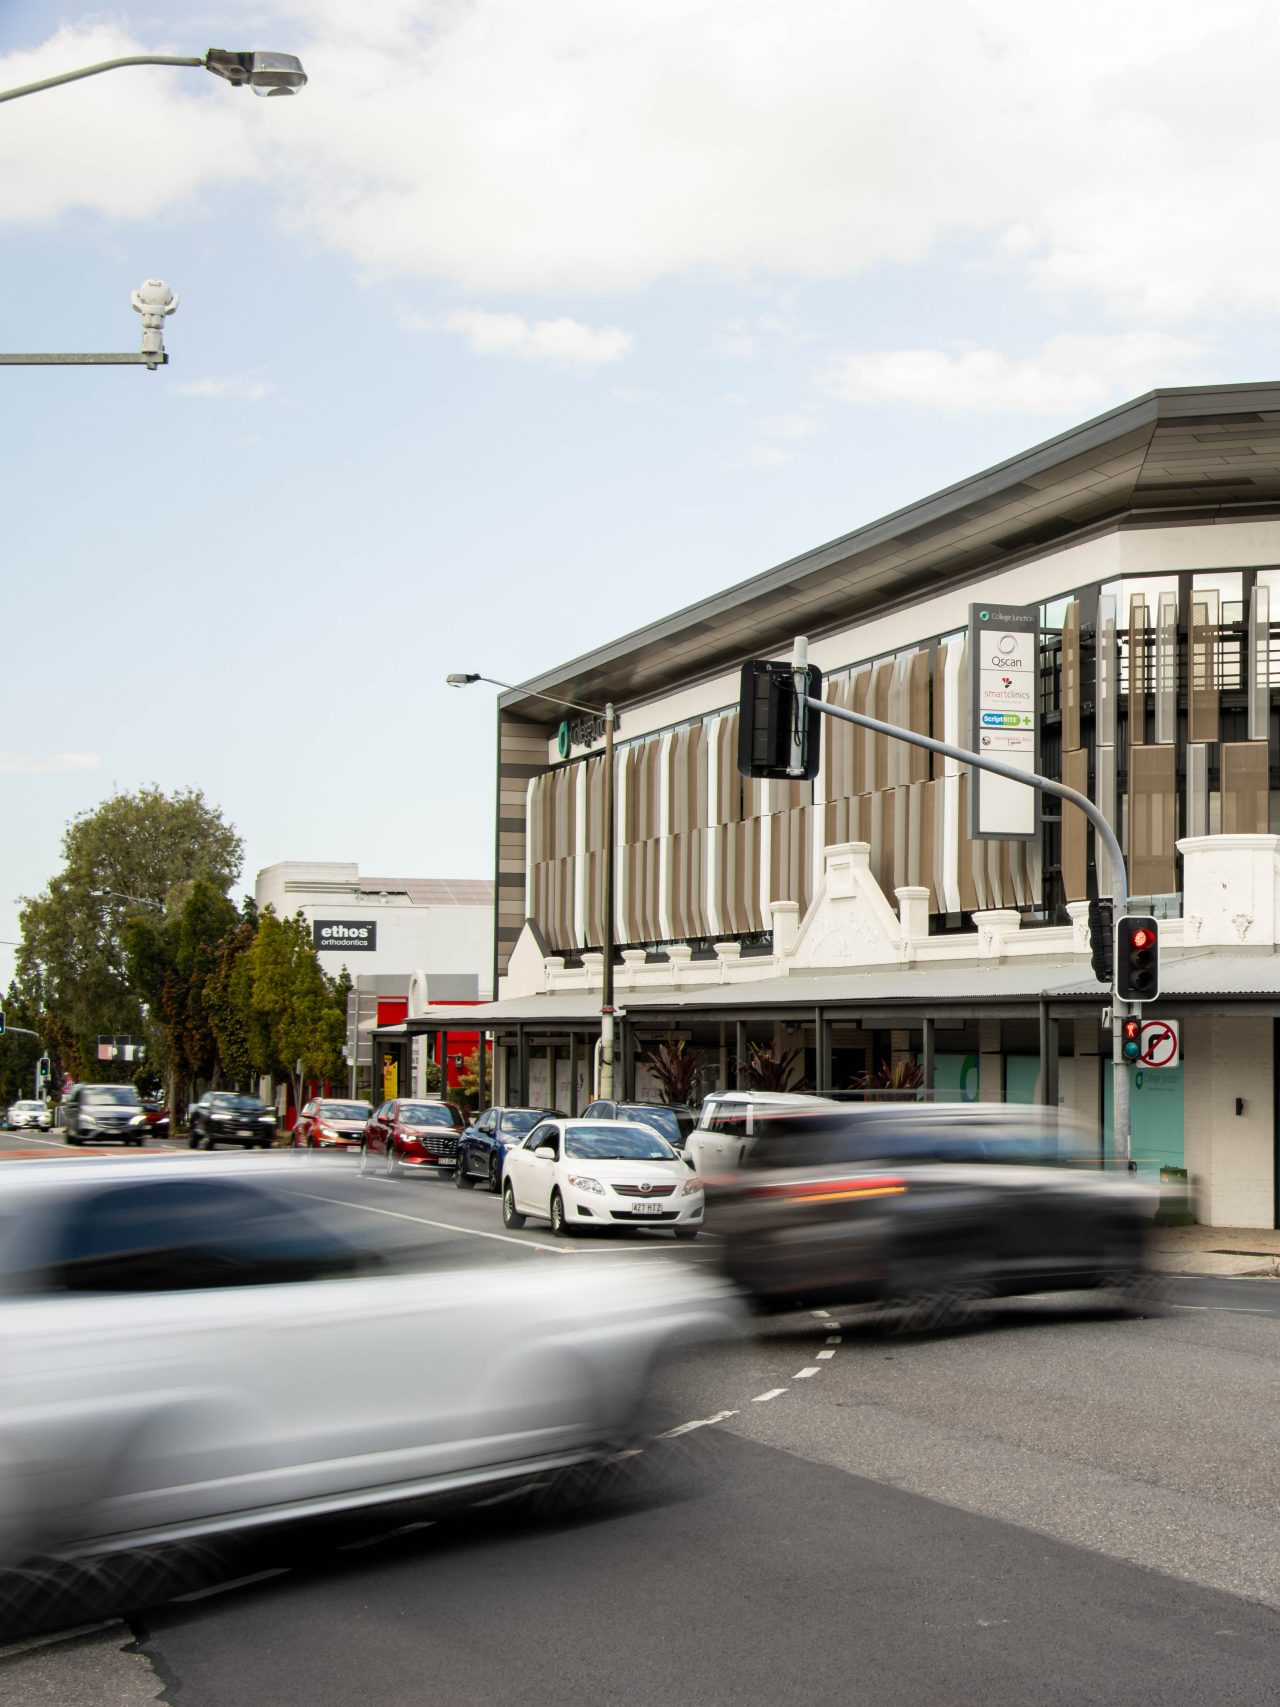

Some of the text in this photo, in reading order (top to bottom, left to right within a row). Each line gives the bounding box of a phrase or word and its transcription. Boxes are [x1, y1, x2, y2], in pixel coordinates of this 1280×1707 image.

[991, 612, 1035, 622] College Junction
[992, 656, 1022, 667] Qscan
[984, 690, 1030, 699] smartclinics
[321, 925, 368, 938] ethos
